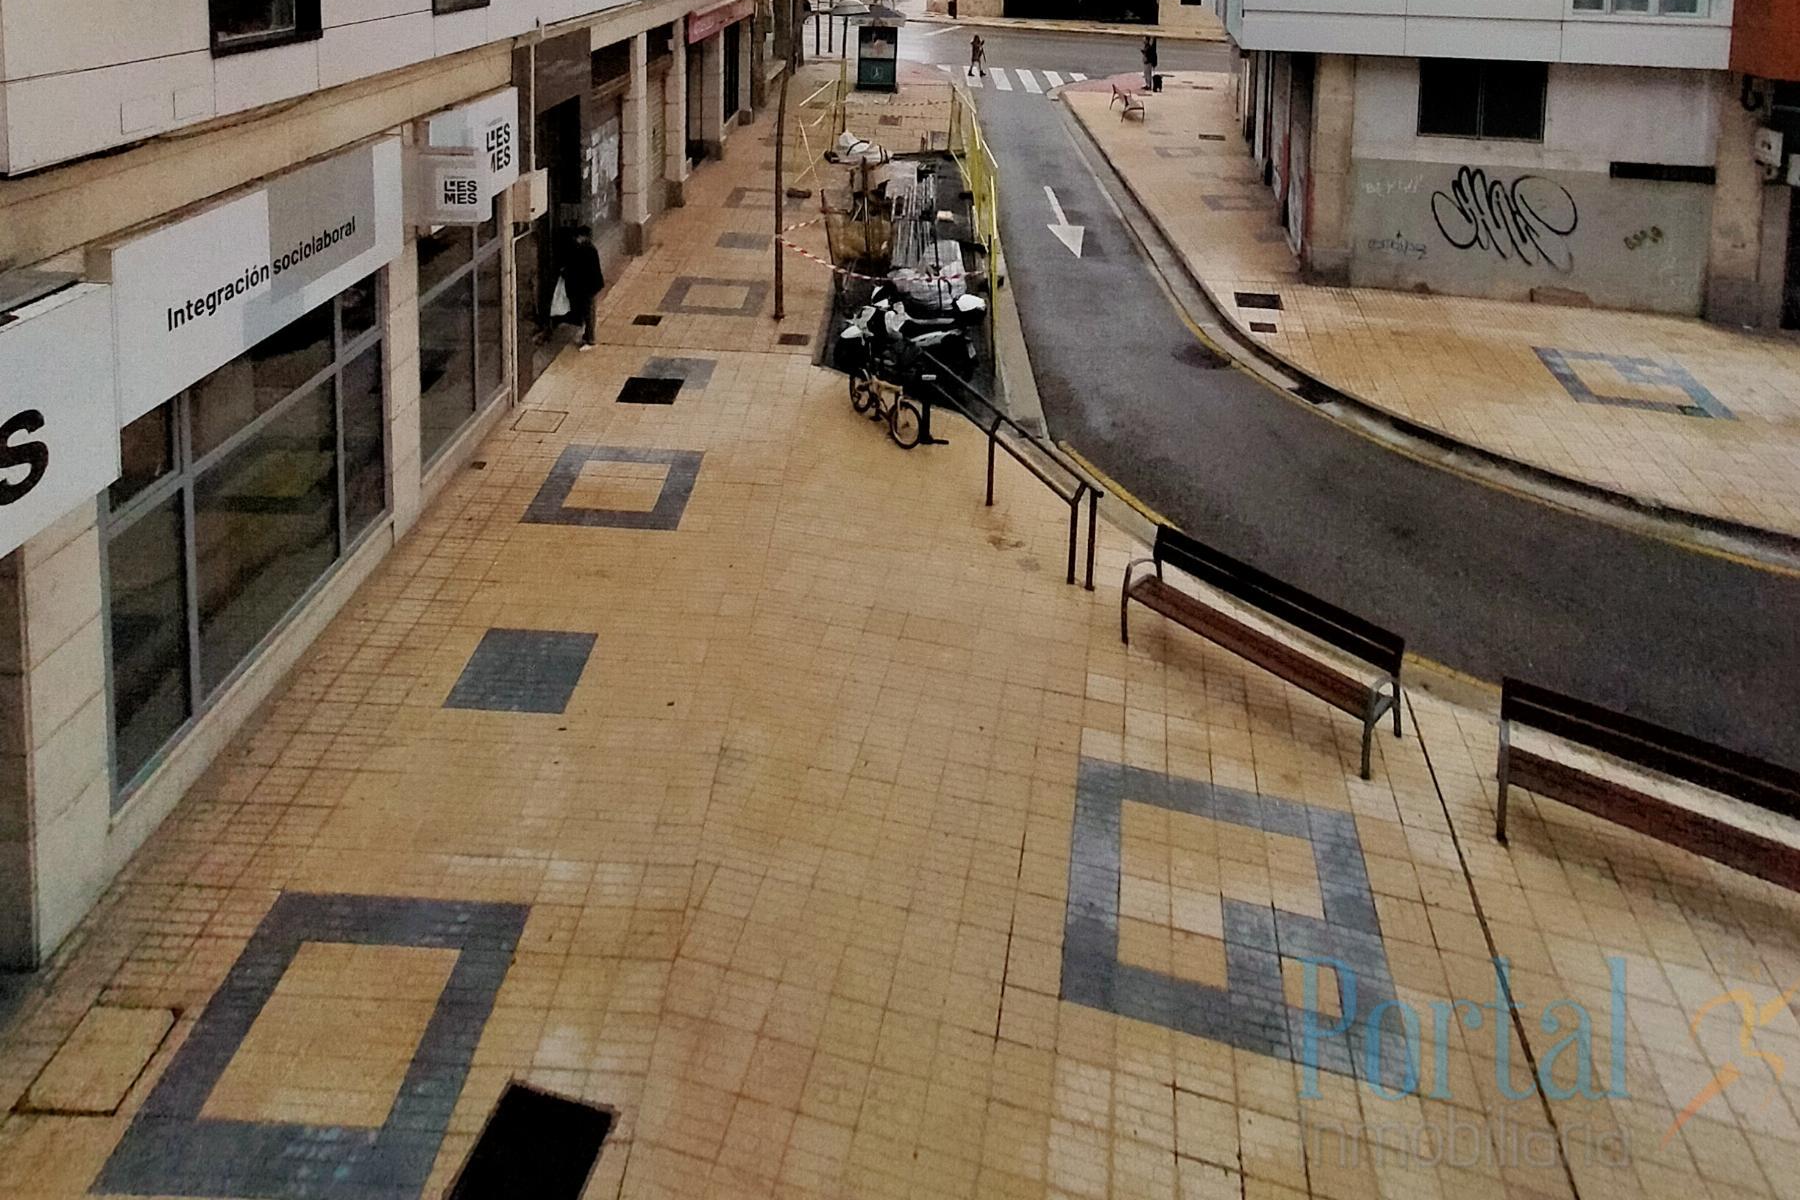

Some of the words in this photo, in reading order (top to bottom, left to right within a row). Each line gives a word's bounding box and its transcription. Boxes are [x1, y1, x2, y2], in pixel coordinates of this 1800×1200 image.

[444, 193, 478, 205] MES
[167, 264, 270, 332] Integración
[272, 215, 356, 275] sociolaboral
